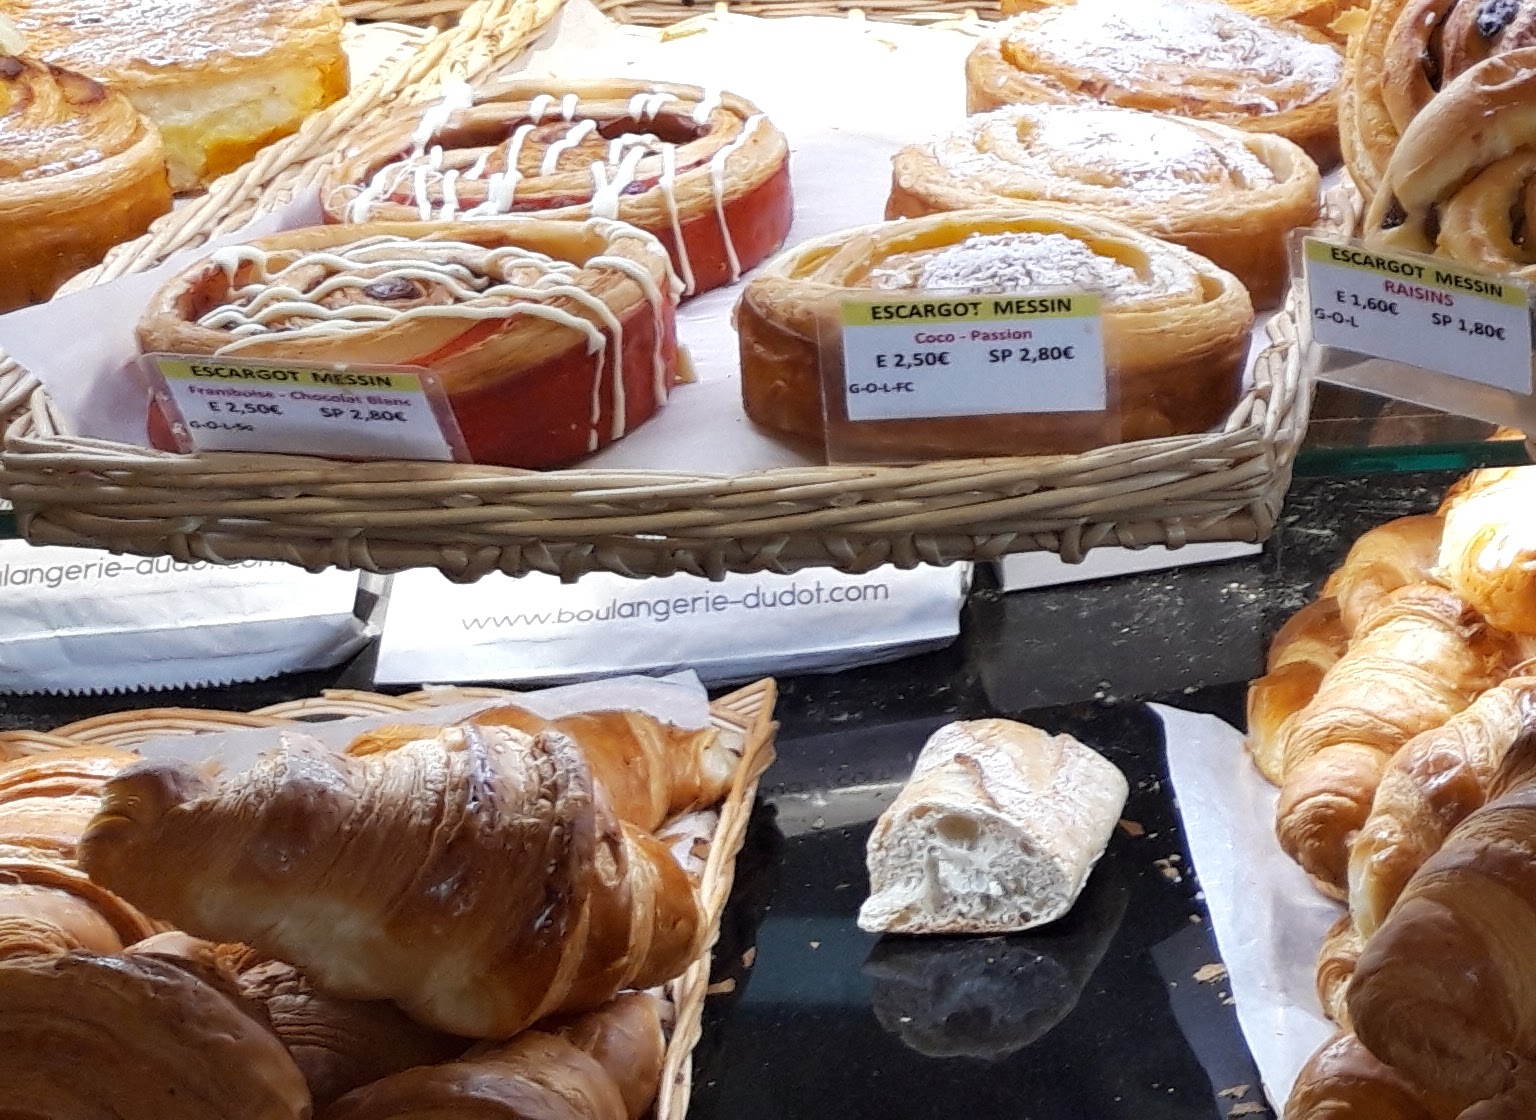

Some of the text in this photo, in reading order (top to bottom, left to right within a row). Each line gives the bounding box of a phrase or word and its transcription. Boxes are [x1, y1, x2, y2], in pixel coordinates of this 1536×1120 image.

[1331, 247, 1502, 297] ESCARGOT MESSIN
[1382, 279, 1454, 307] RAISINS
[871, 298, 1072, 320] ESCARGOT MESSIN
[1314, 307, 1360, 328] G-O-L
[1336, 290, 1506, 341] E 1,60€ SP 1,80€
[914, 332, 955, 344] Coco
[970, 329, 1033, 342] Passion
[876, 346, 1075, 369] E 2,50€ SP 2,80€
[190, 365, 392, 387] ESCARGOT MESSIN
[188, 385, 274, 398] Framboise
[290, 390, 362, 404] Chocolat
[366, 394, 412, 407] Blanc
[209, 402, 407, 422] E 2,50€ SP 2,80€
[462, 580, 890, 631] www.boulangerie-dudot.com
